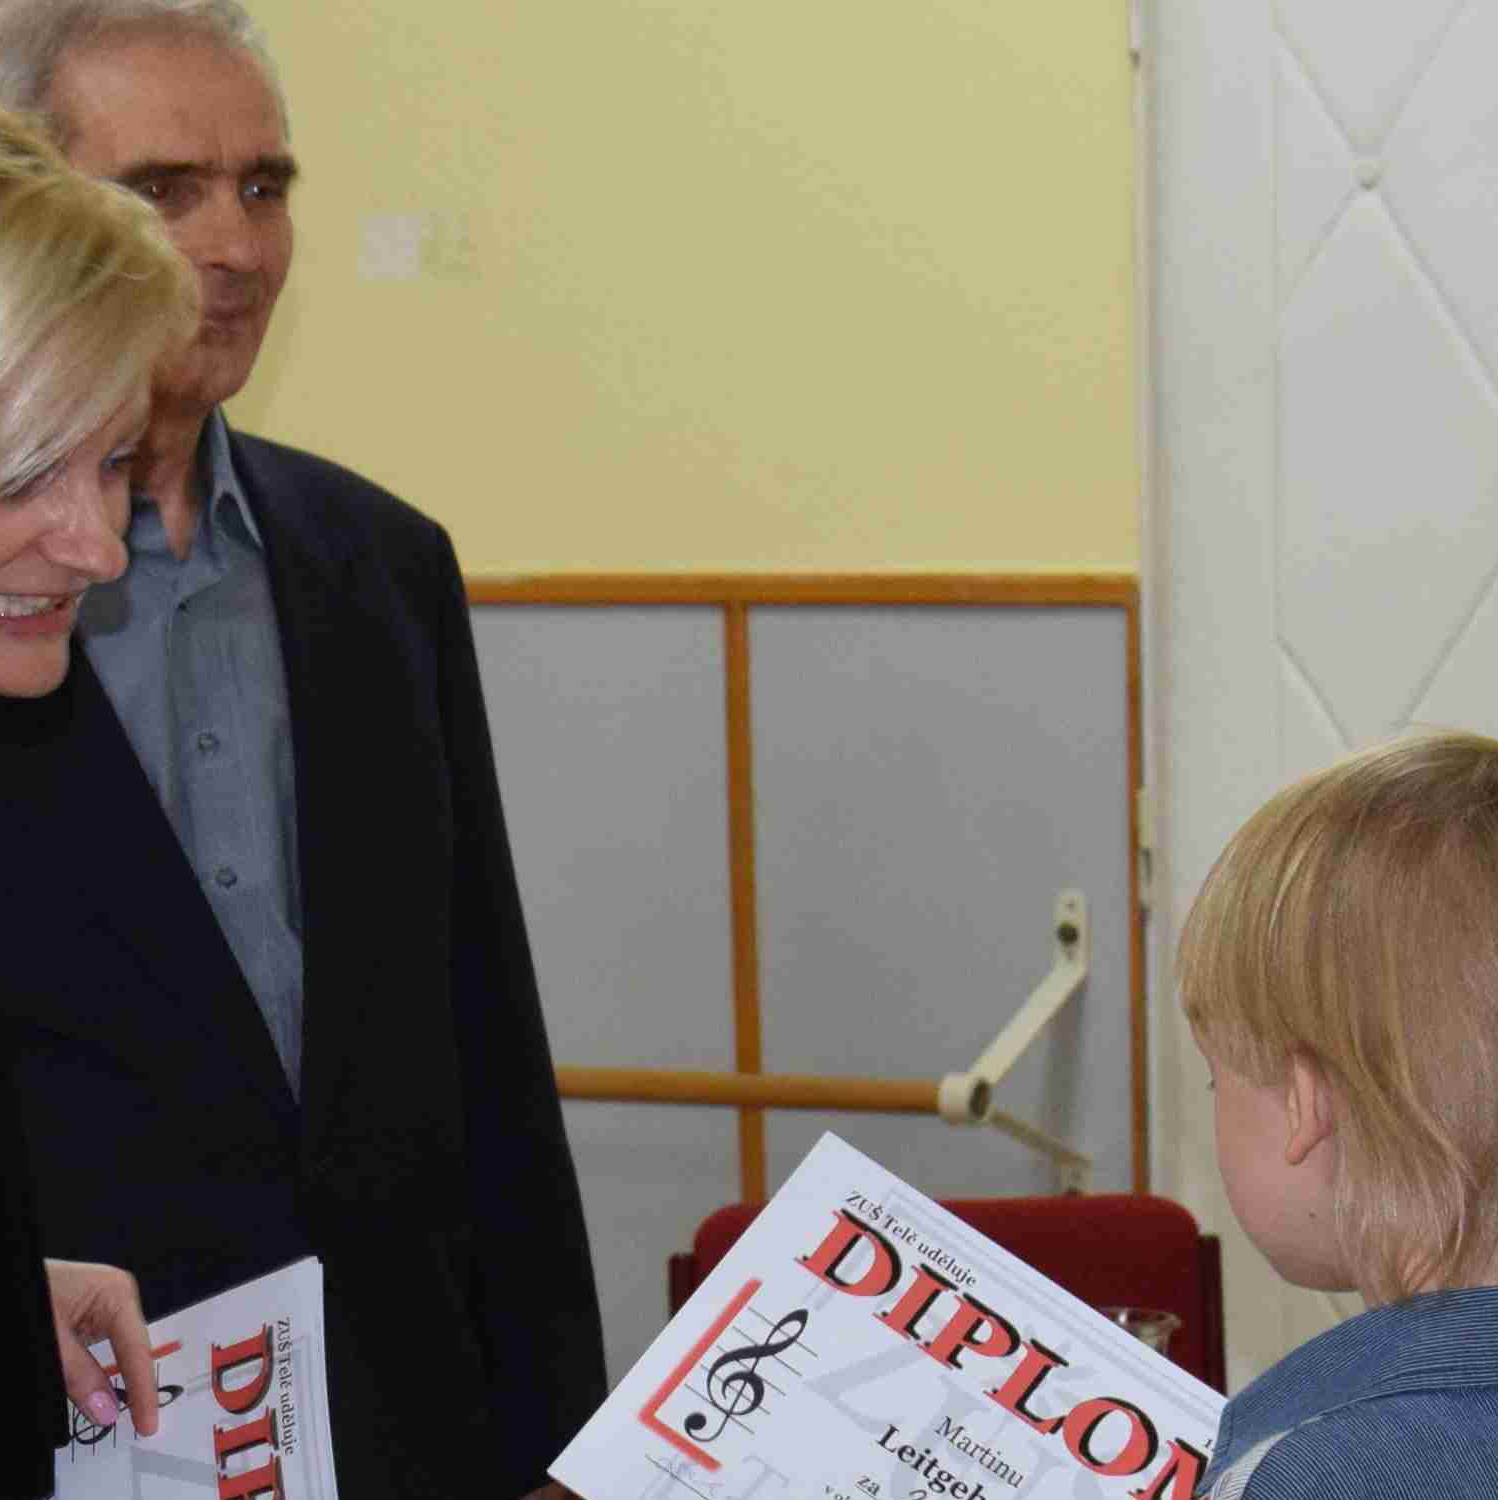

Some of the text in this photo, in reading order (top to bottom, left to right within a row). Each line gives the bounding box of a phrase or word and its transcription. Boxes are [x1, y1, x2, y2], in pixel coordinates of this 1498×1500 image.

[845, 1190, 978, 1289] ZUŠ Telč uděluje
[277, 1316, 293, 1353] ZUŠ
[280, 1391, 298, 1456] uděluje
[935, 1415, 1025, 1489] Martinu
[856, 1474, 882, 1497] za
